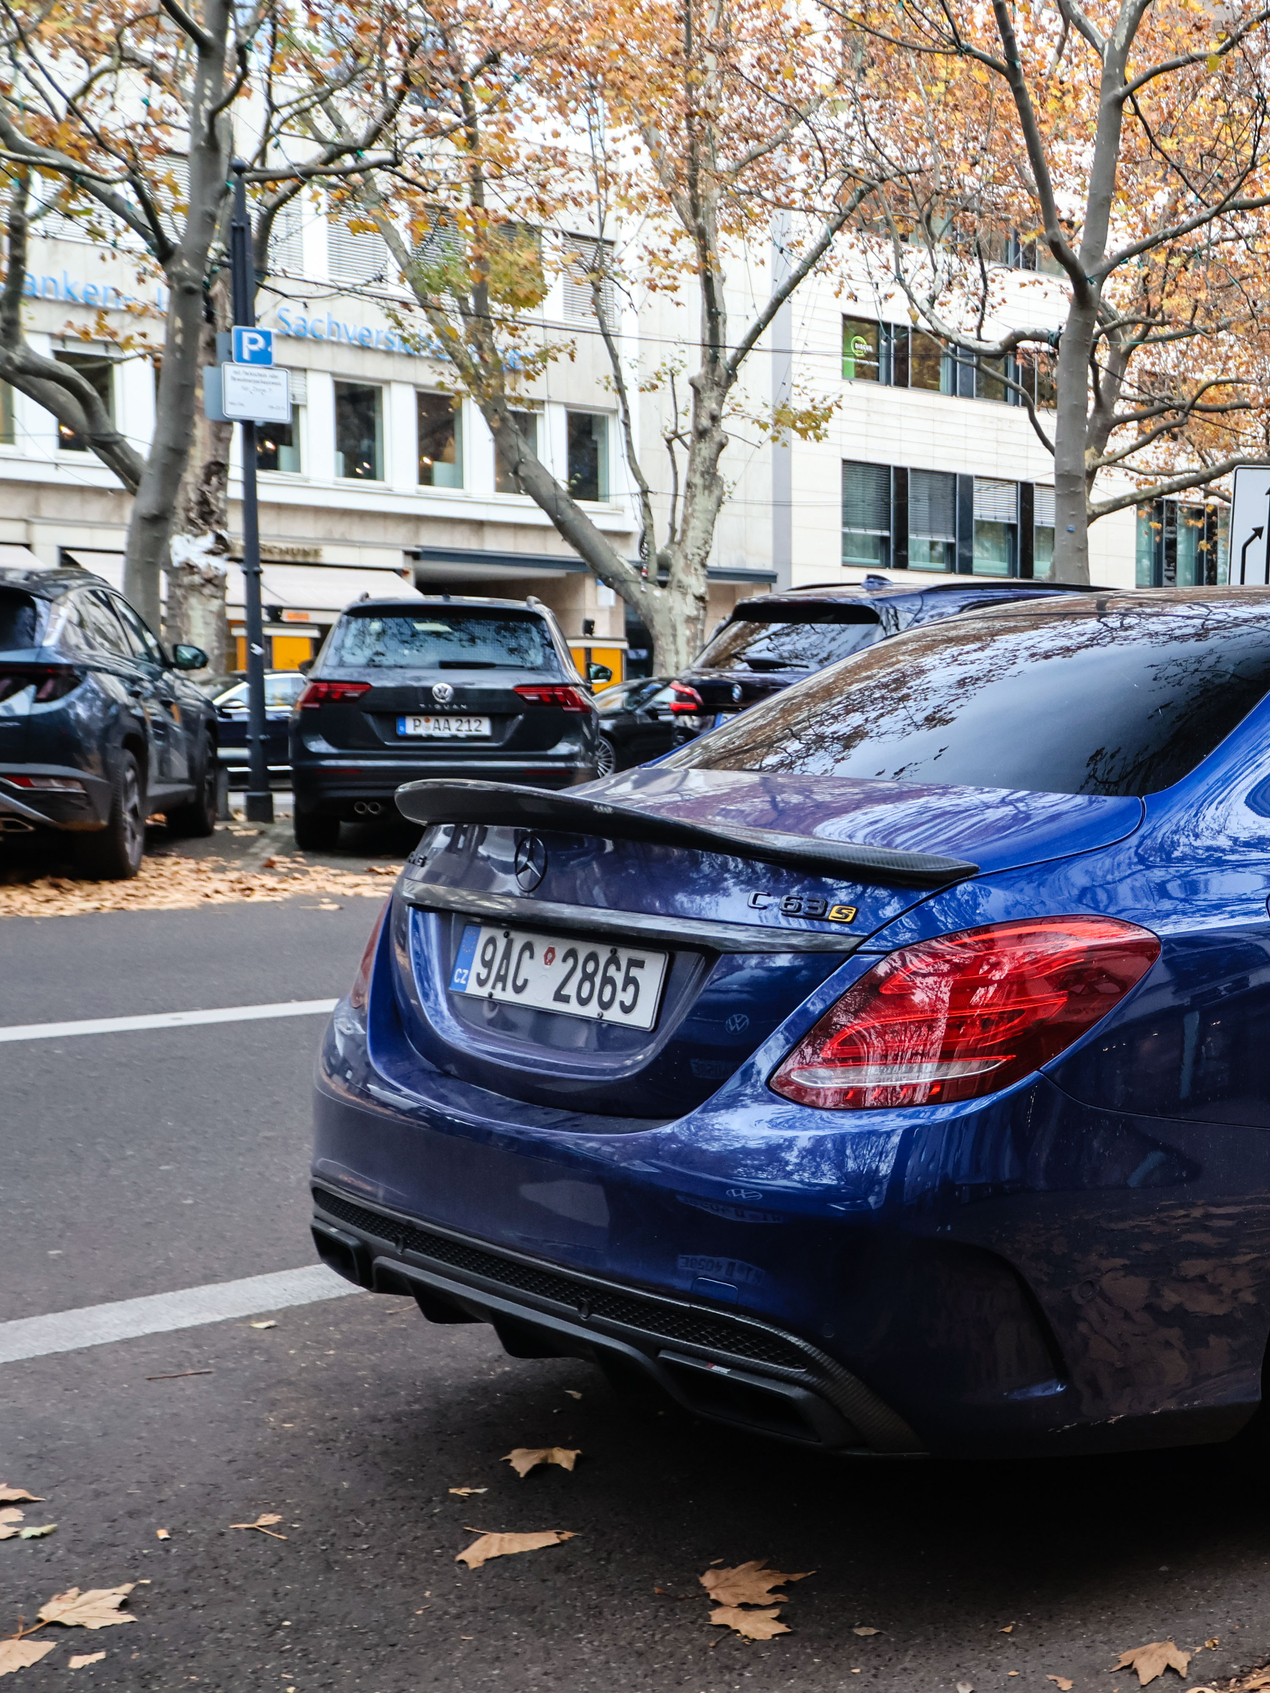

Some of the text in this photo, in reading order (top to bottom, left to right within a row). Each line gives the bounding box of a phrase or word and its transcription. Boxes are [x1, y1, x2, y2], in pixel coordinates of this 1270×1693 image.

[242, 331, 266, 361] P
[413, 718, 482, 733] P AA 212
[747, 890, 771, 910] C
[454, 968, 469, 984] CZ
[476, 936, 646, 1014] 9AC 2865
